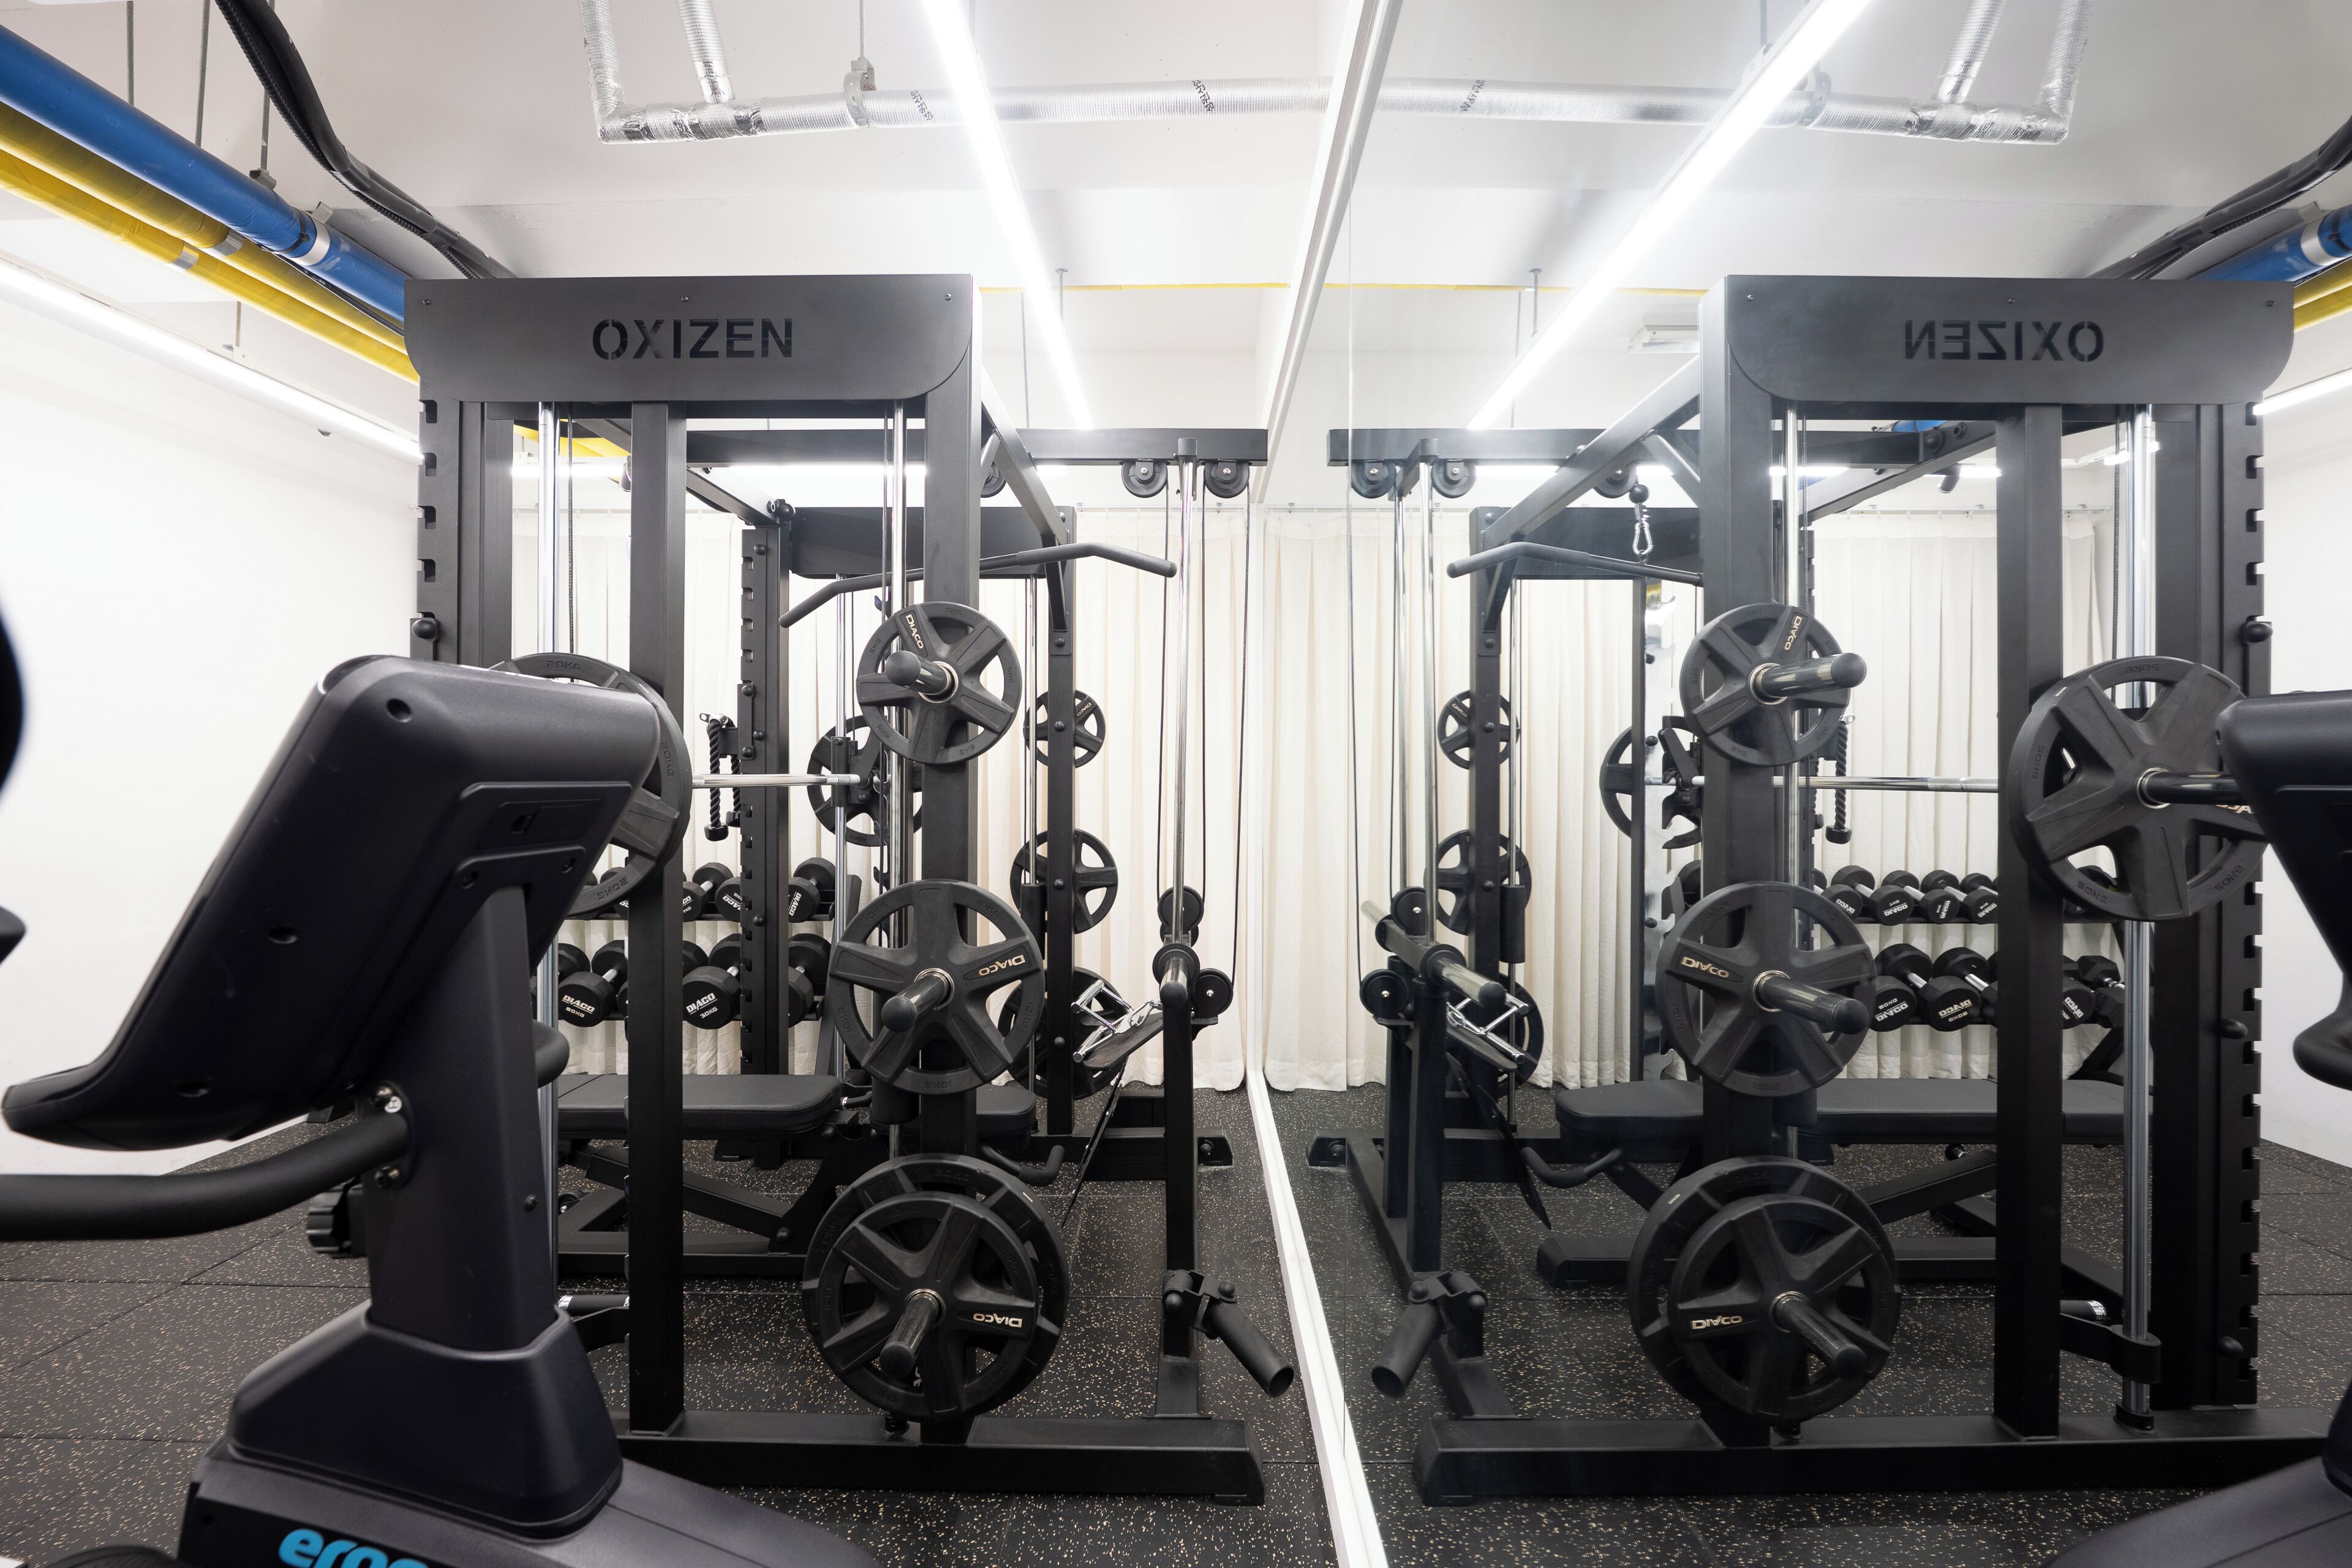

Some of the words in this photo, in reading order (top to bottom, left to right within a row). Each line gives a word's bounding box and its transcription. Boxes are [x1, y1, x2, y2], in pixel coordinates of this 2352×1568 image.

[592, 317, 793, 361] OXIZEN
[944, 607, 963, 616] 5KG
[905, 613, 924, 650] DIACO
[869, 638, 882, 655] 5KG
[547, 660, 581, 671] 20KG
[1077, 703, 1092, 716] DIACO
[877, 723, 892, 739] 5KG
[661, 741, 675, 777] 20KG
[959, 744, 976, 756] 5KG
[597, 876, 628, 900] 20KG
[722, 895, 741, 911] IACO
[788, 892, 802, 916] DIACO
[865, 901, 888, 921] 10KG
[976, 899, 1001, 919] 10KG
[978, 954, 1026, 976] DIACO
[562, 995, 595, 1012] DIACO
[686, 992, 717, 1014] DIACO
[699, 1006, 718, 1019] 30KG
[837, 1007, 852, 1035] 10KG
[1022, 1002, 1033, 1029] 10KG
[973, 1313, 1023, 1329] DIACO
